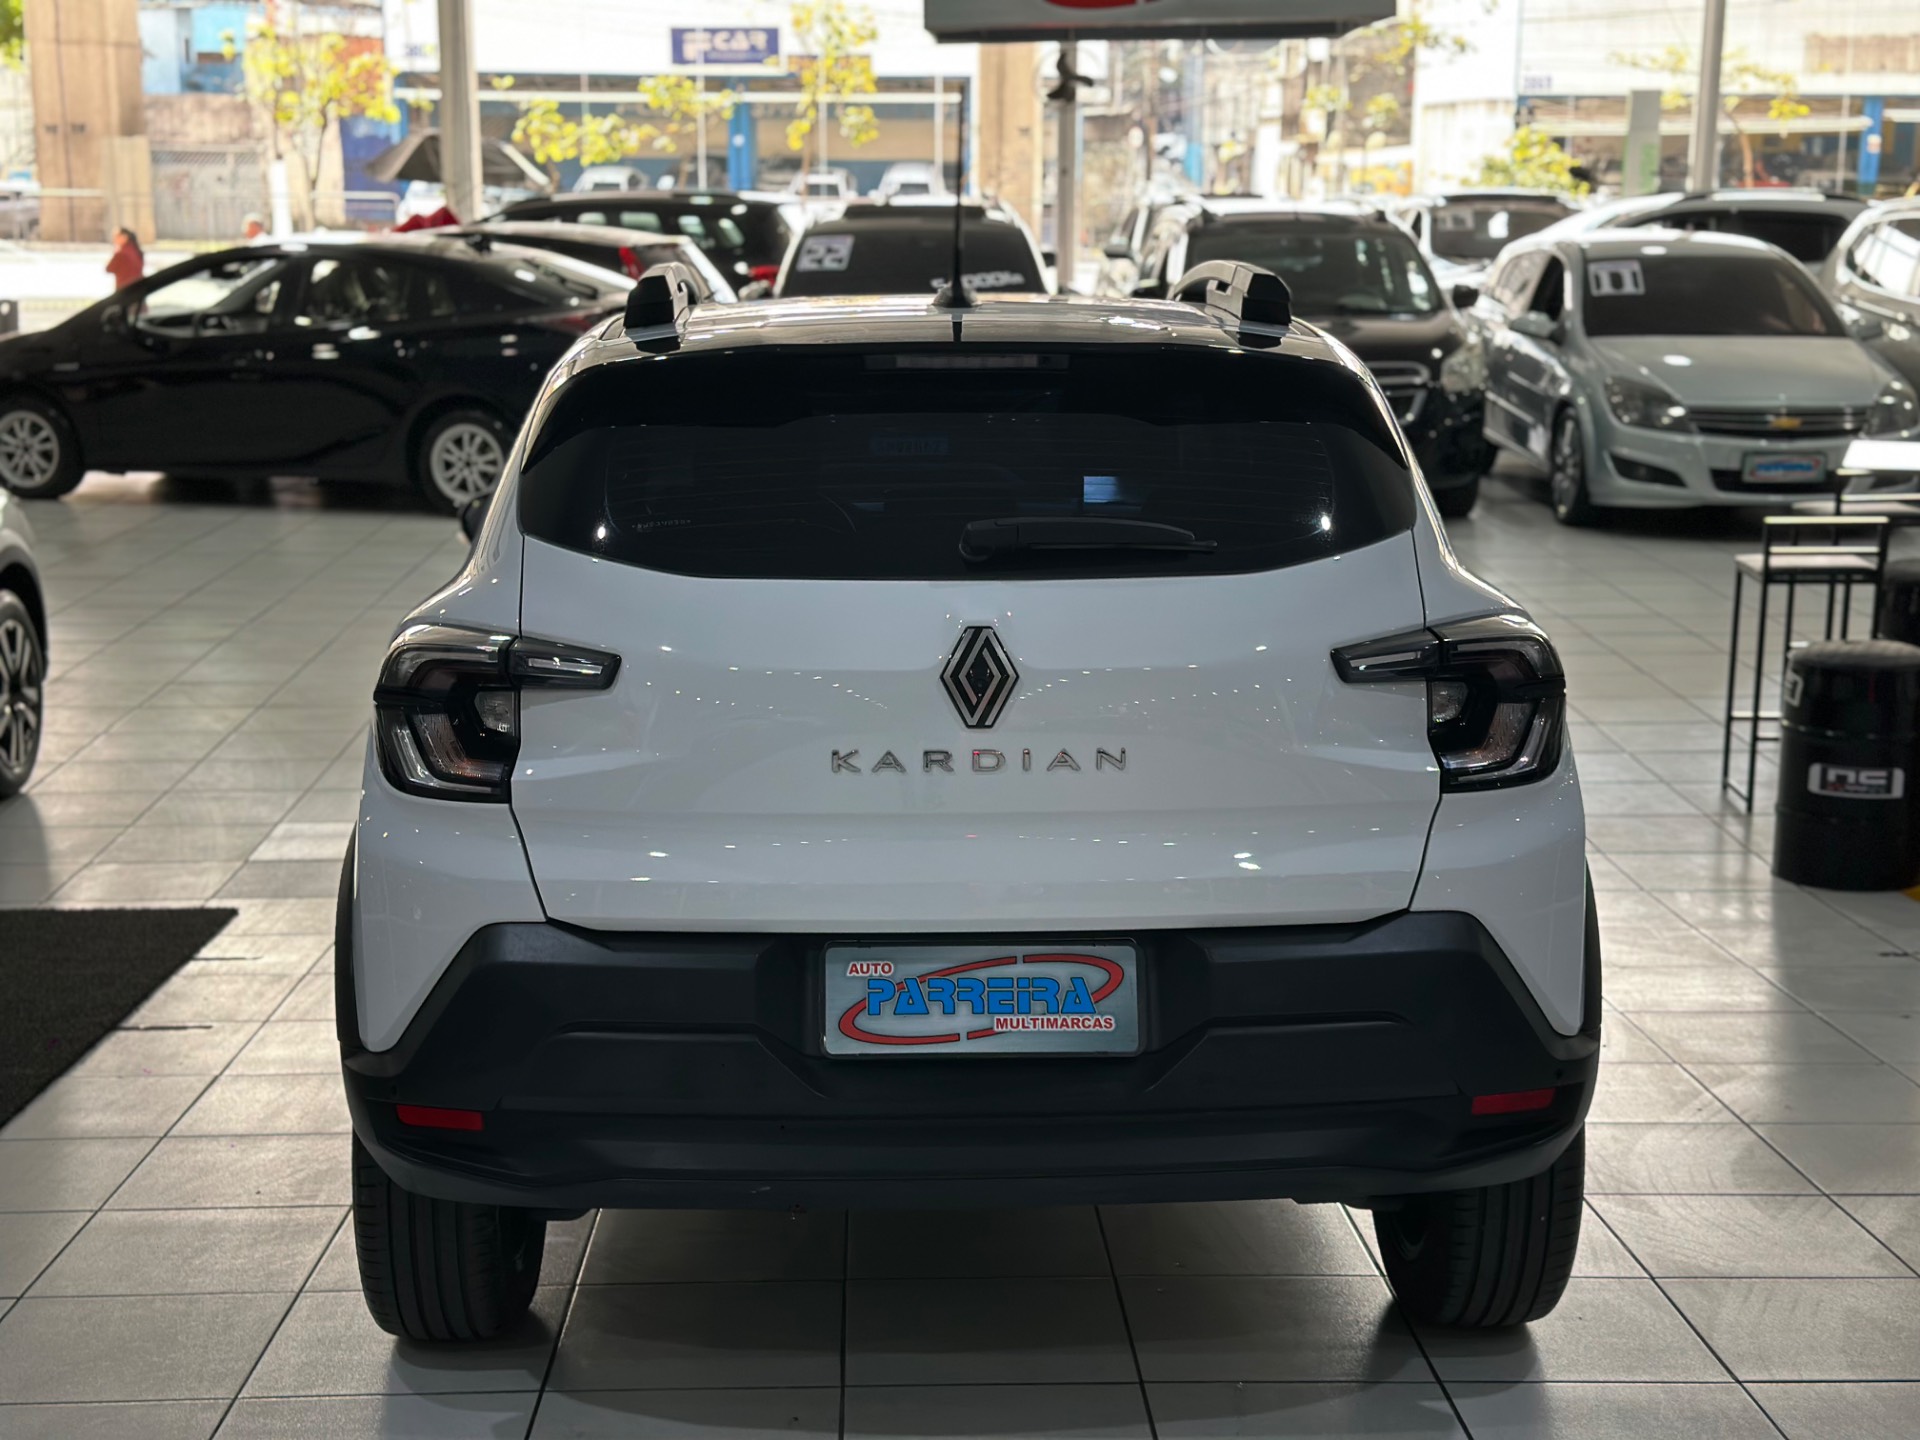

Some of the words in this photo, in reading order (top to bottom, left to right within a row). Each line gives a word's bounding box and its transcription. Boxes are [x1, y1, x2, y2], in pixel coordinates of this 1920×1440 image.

[806, 244, 846, 271] 22
[848, 962, 893, 976] AUTO
[995, 1017, 1115, 1031] MULTIMARCAS
